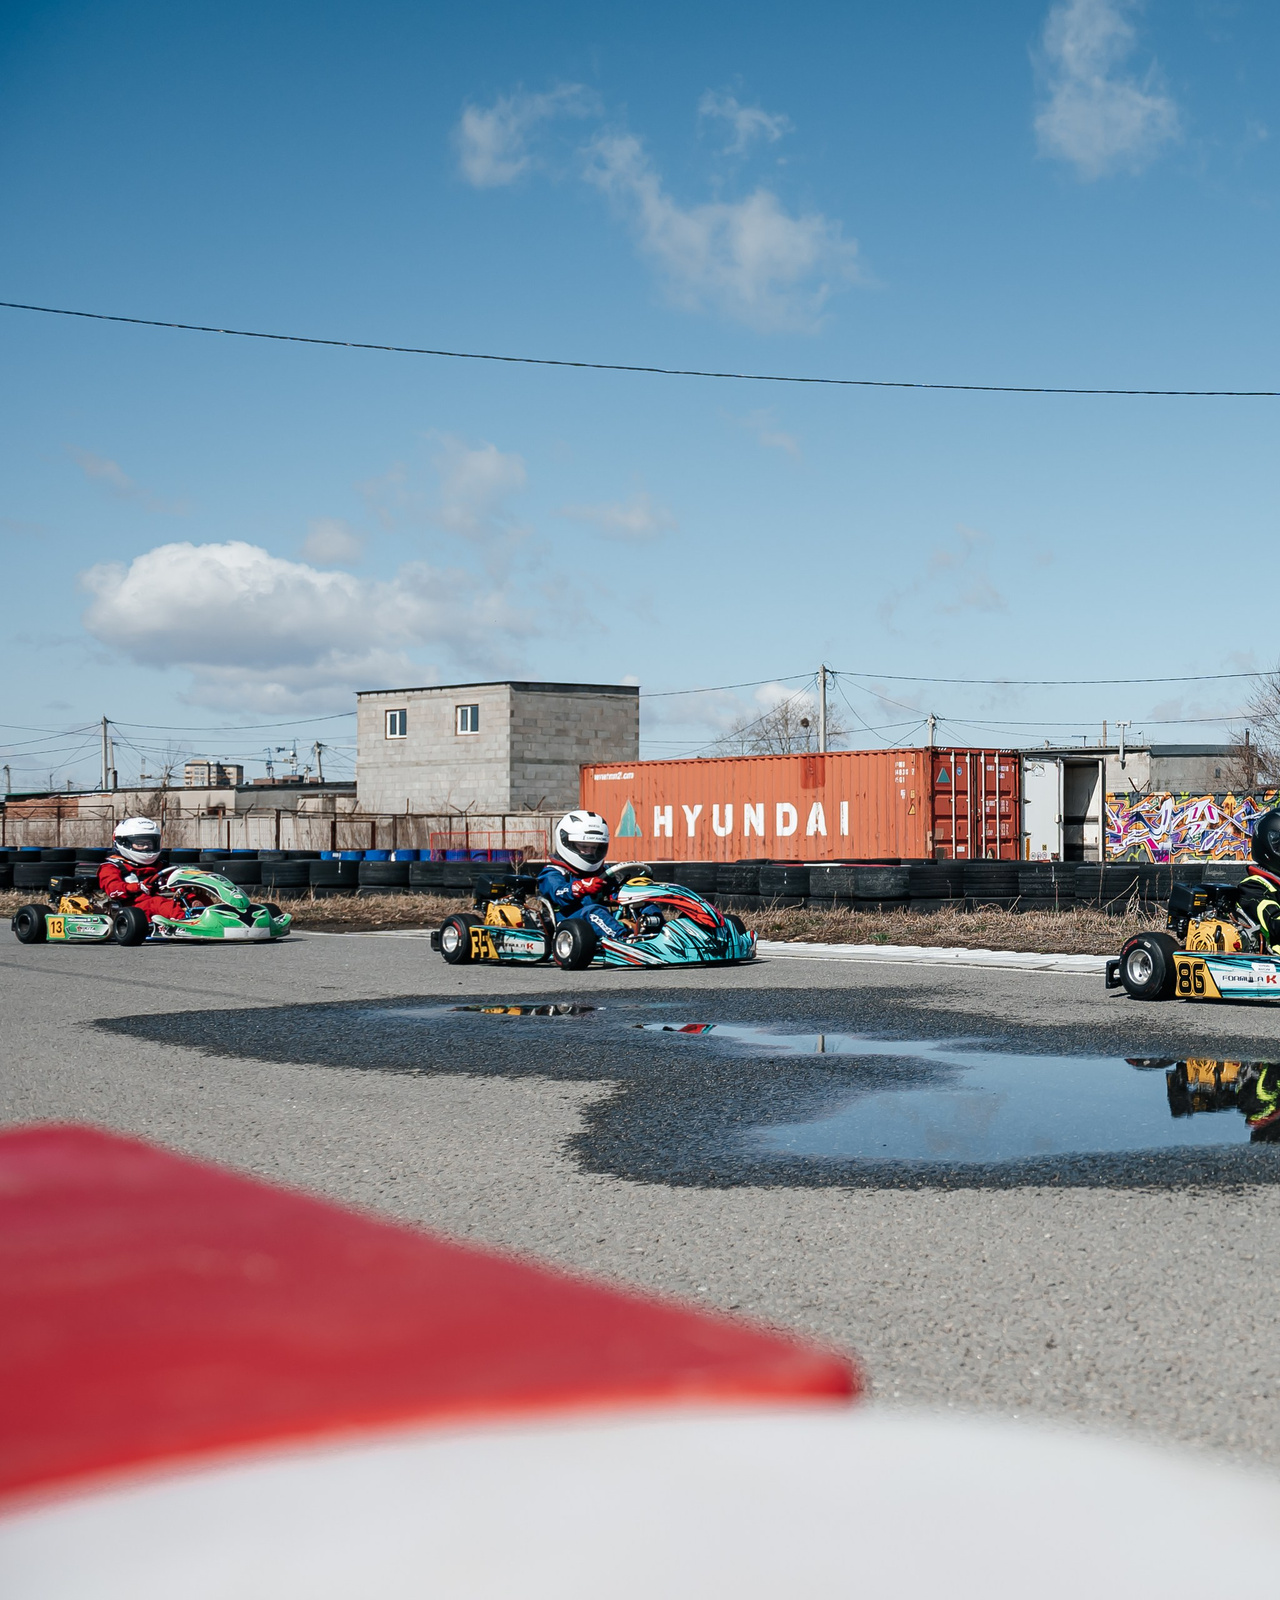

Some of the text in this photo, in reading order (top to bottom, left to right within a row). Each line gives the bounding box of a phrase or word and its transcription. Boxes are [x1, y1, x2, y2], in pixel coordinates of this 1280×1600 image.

[653, 801, 849, 838] HYUNDAI
[50, 921, 63, 934] 13
[1178, 961, 1205, 995] 86
[1266, 974, 1277, 984] K
